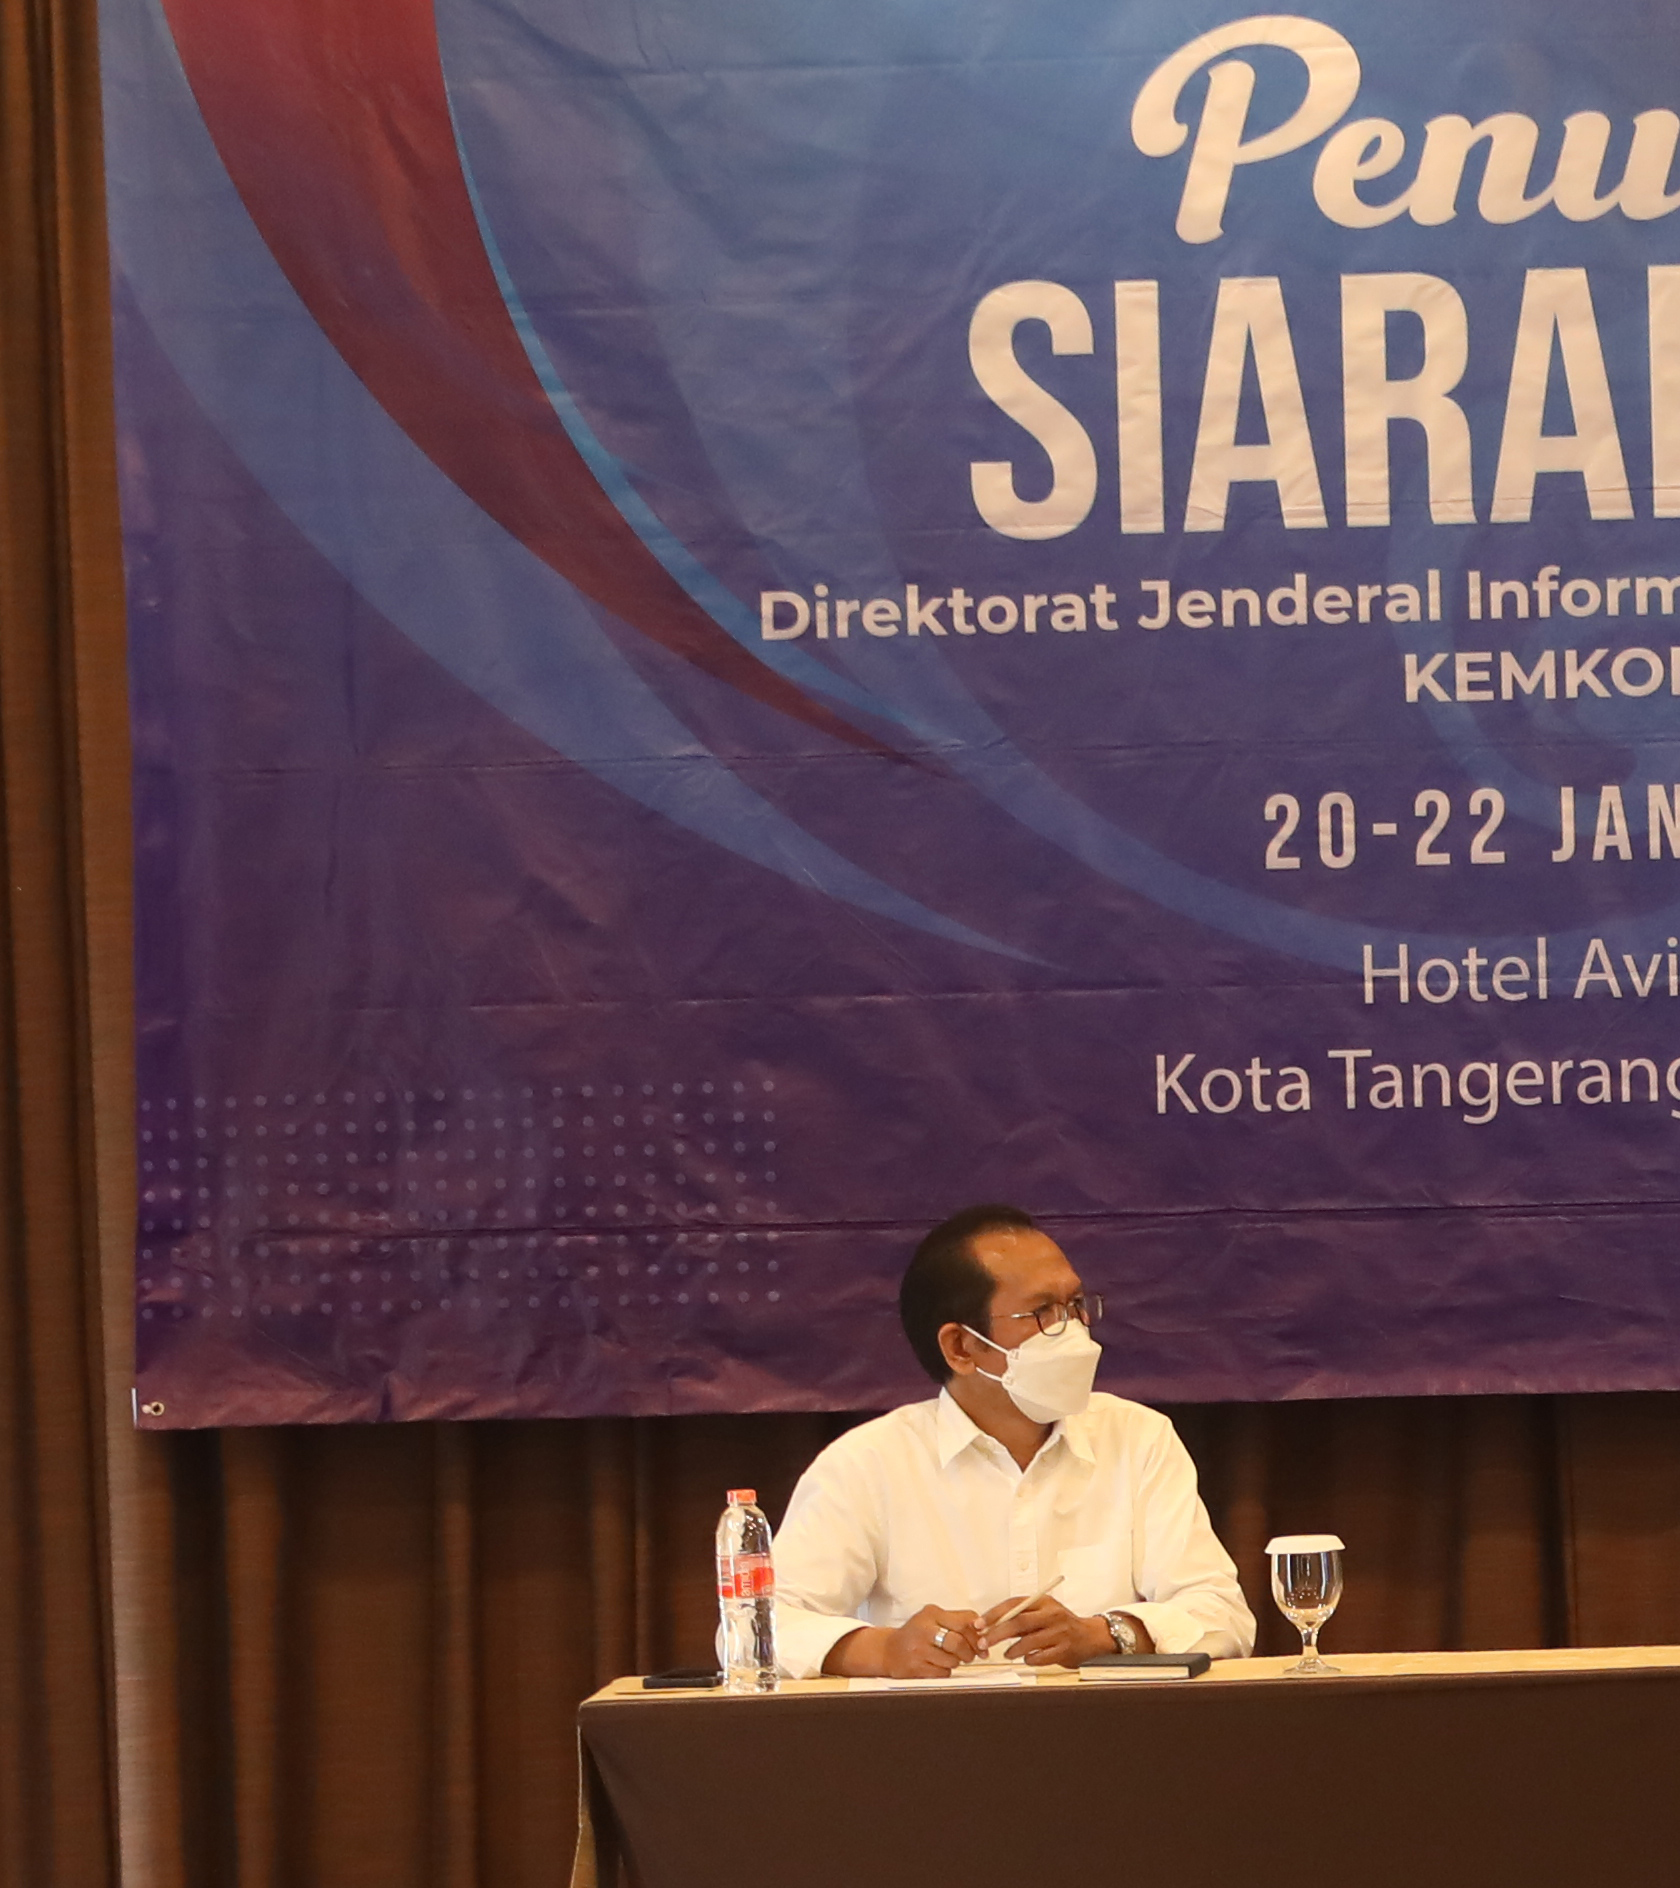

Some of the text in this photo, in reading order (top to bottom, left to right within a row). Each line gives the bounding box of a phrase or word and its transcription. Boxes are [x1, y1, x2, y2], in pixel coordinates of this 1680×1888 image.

[761, 585, 1118, 640] Direktorat
[1138, 569, 1440, 629] Jenderal
[1265, 788, 1504, 869] 20-22
[1364, 937, 1547, 1003] Hotel
[1157, 1054, 1310, 1113] Kota
